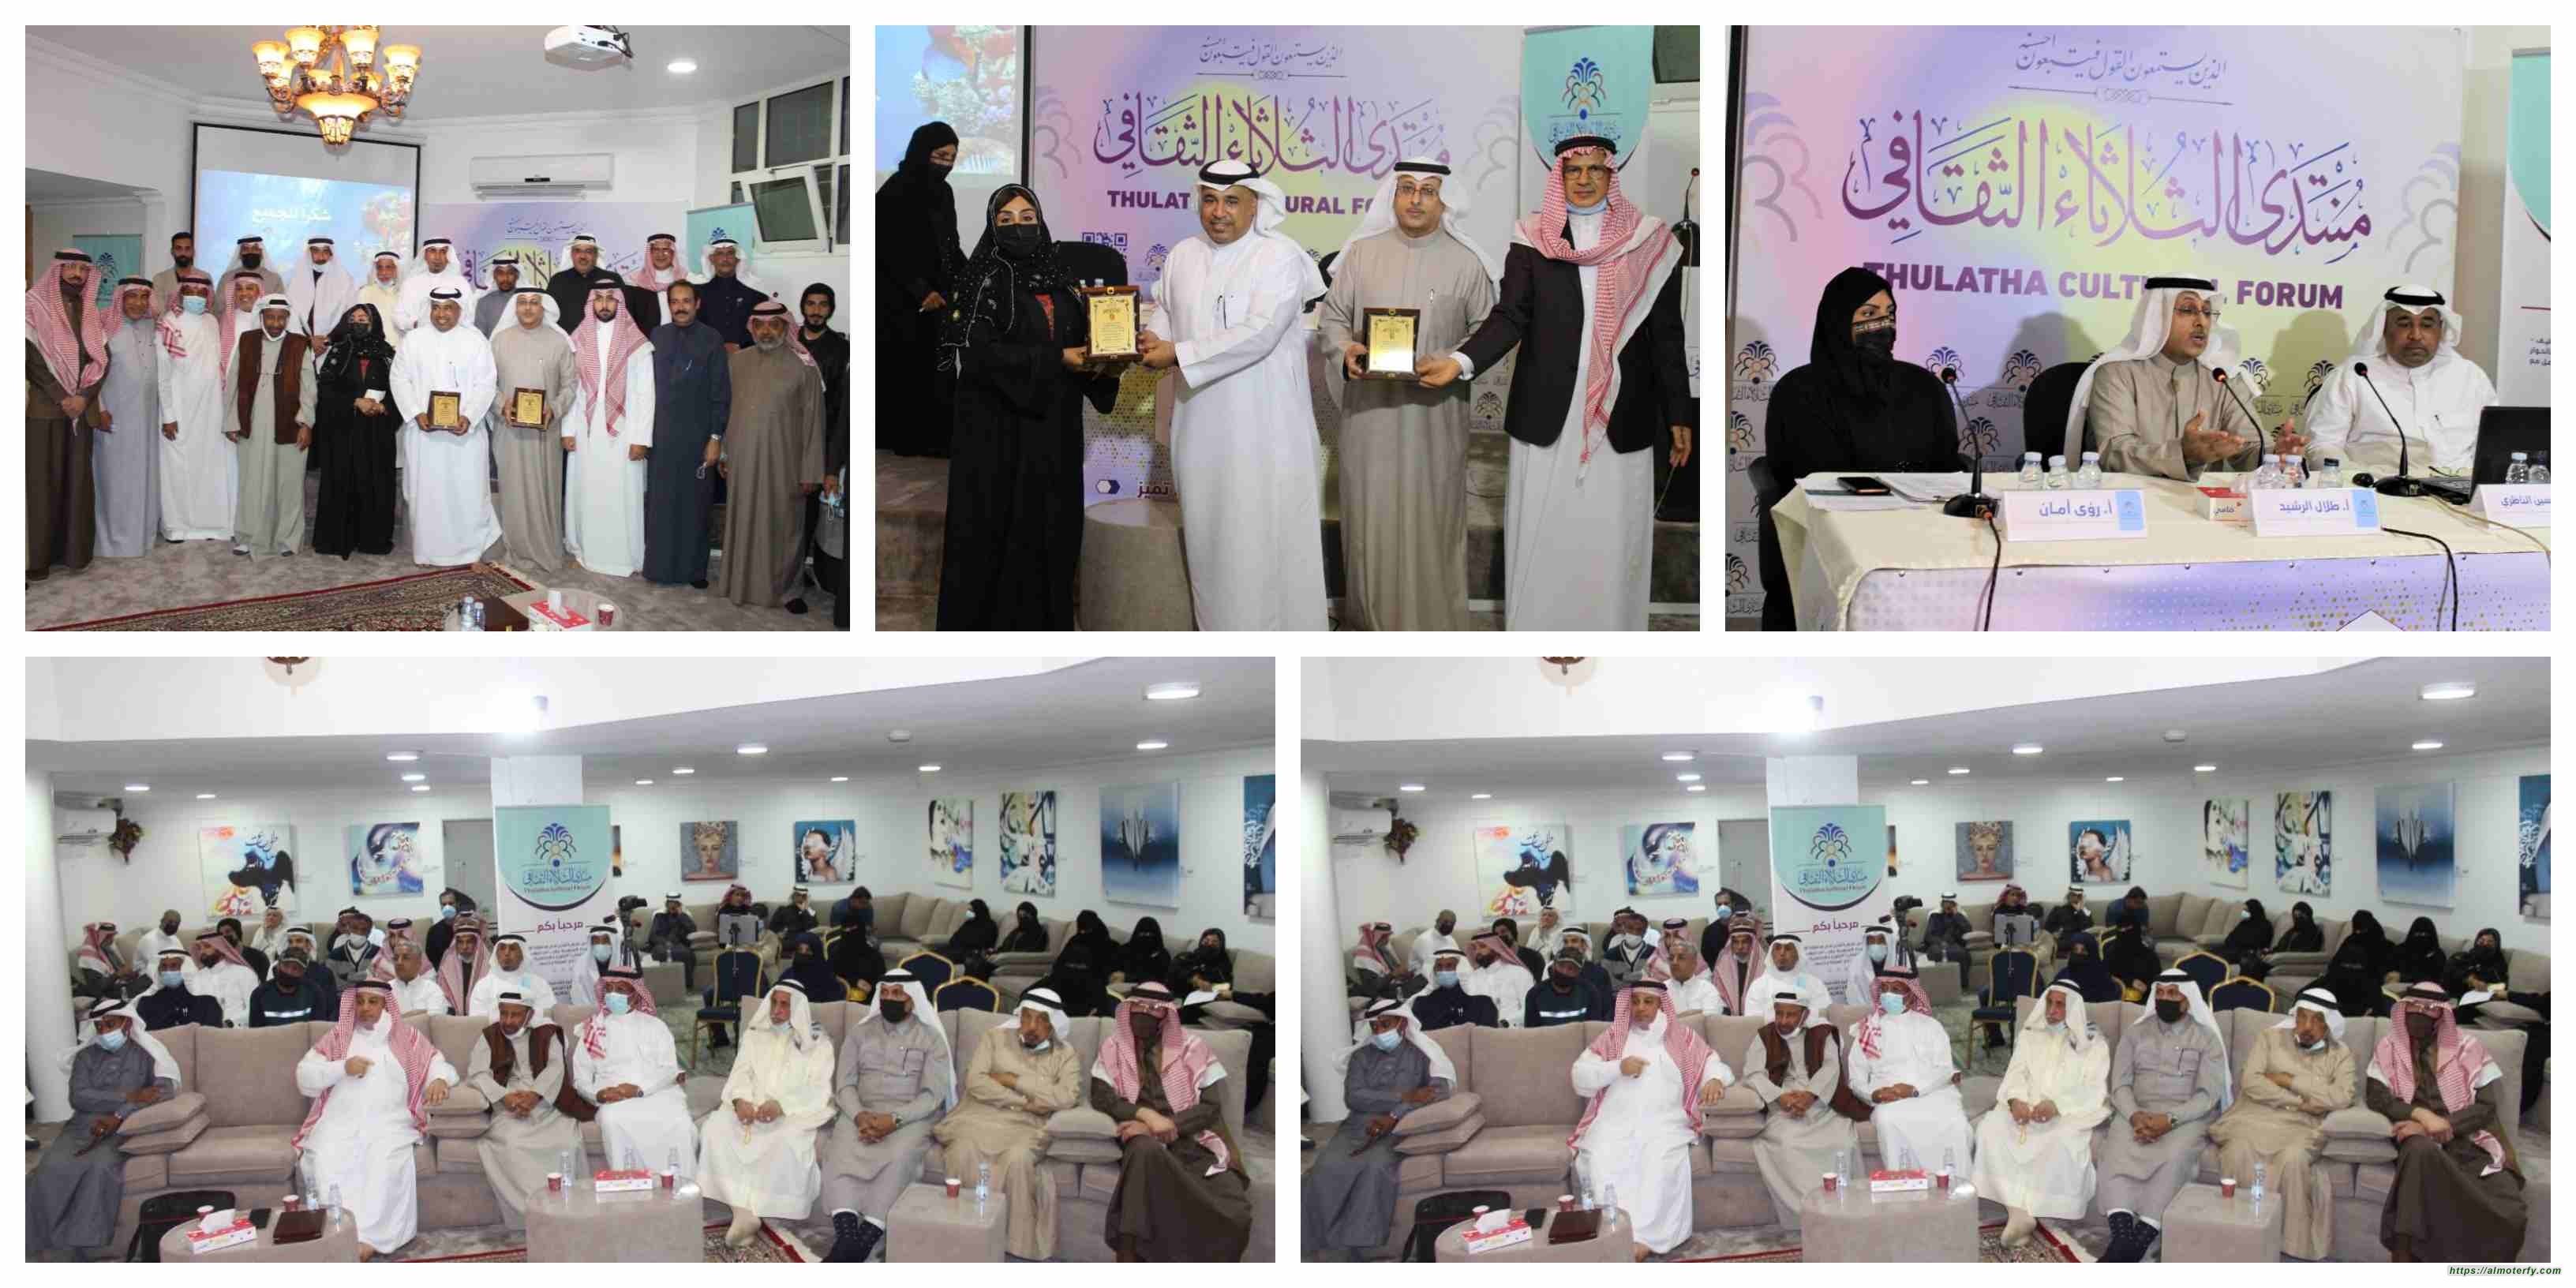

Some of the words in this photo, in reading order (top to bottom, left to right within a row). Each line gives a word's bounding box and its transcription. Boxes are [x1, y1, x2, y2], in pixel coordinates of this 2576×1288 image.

[2123, 51, 2207, 85] يستمعون
[2188, 58, 2228, 89] الذين
[1094, 92, 1222, 175] الثقافي
[1842, 109, 2049, 238] الثقافي
[2054, 123, 2241, 246] الثلاثاء
[1107, 190, 1191, 210] THULAT
[2226, 156, 2372, 259] منتدى
[2237, 280, 2343, 309] FORUM
[2279, 498, 2313, 513] الرشيد
[2316, 498, 2340, 513] طلال
[537, 920, 556, 934] بكم
[1812, 920, 1831, 934] بكم
